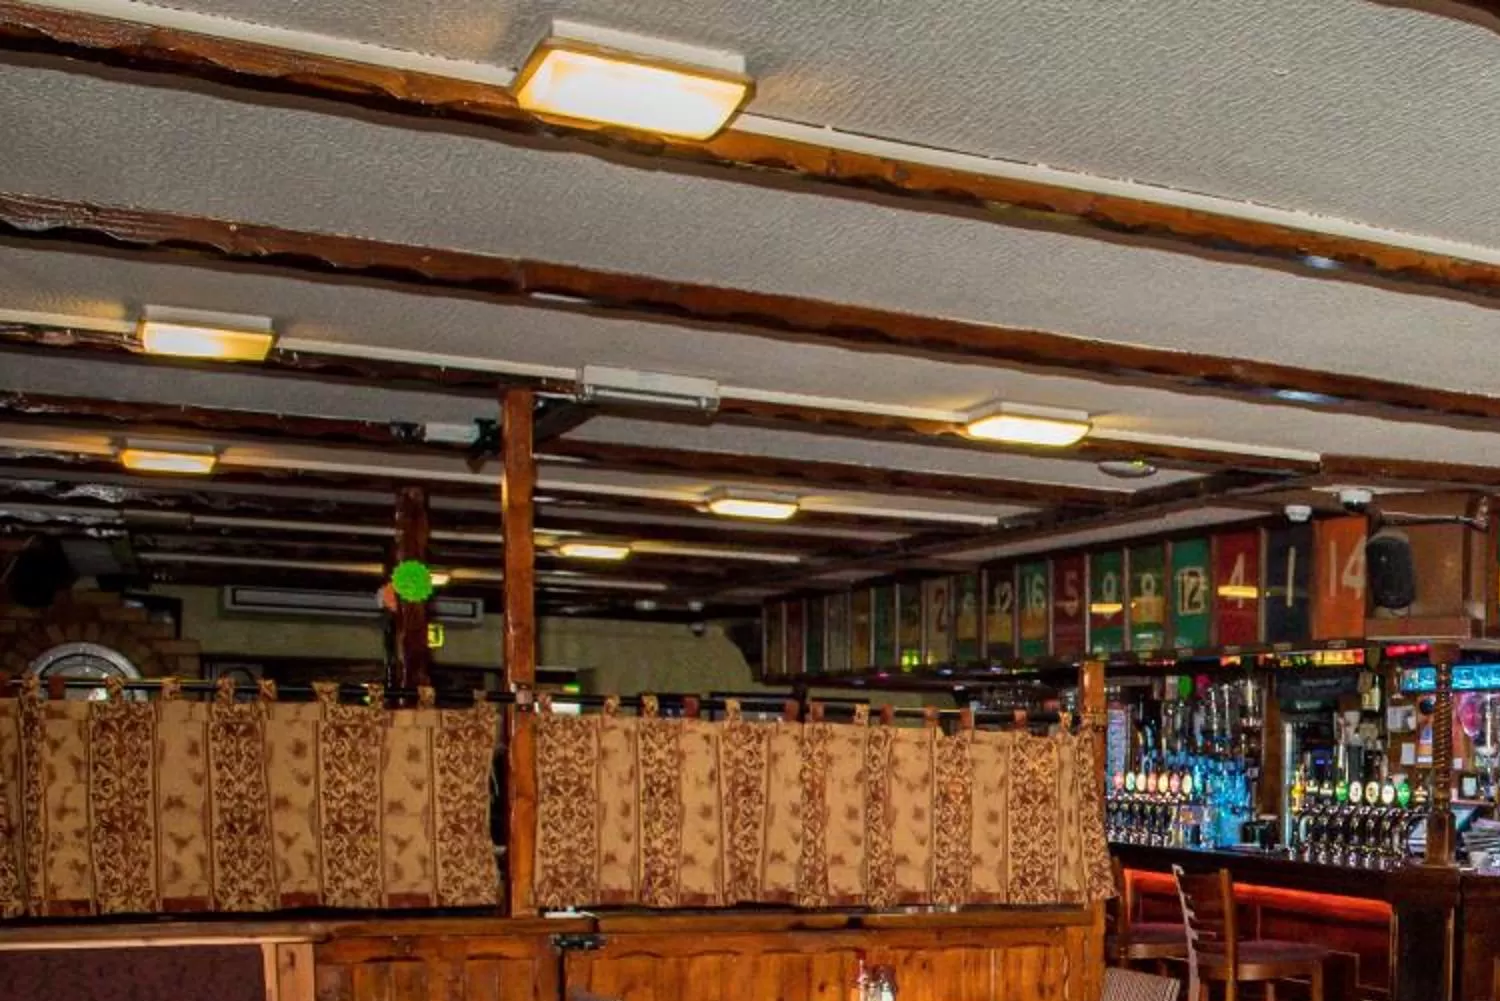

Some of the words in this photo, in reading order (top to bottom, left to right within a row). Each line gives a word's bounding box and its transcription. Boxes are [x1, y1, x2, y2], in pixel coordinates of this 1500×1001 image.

[1229, 552, 1245, 609] 4
[1286, 547, 1296, 607] 1
[1330, 535, 1367, 599] 14
